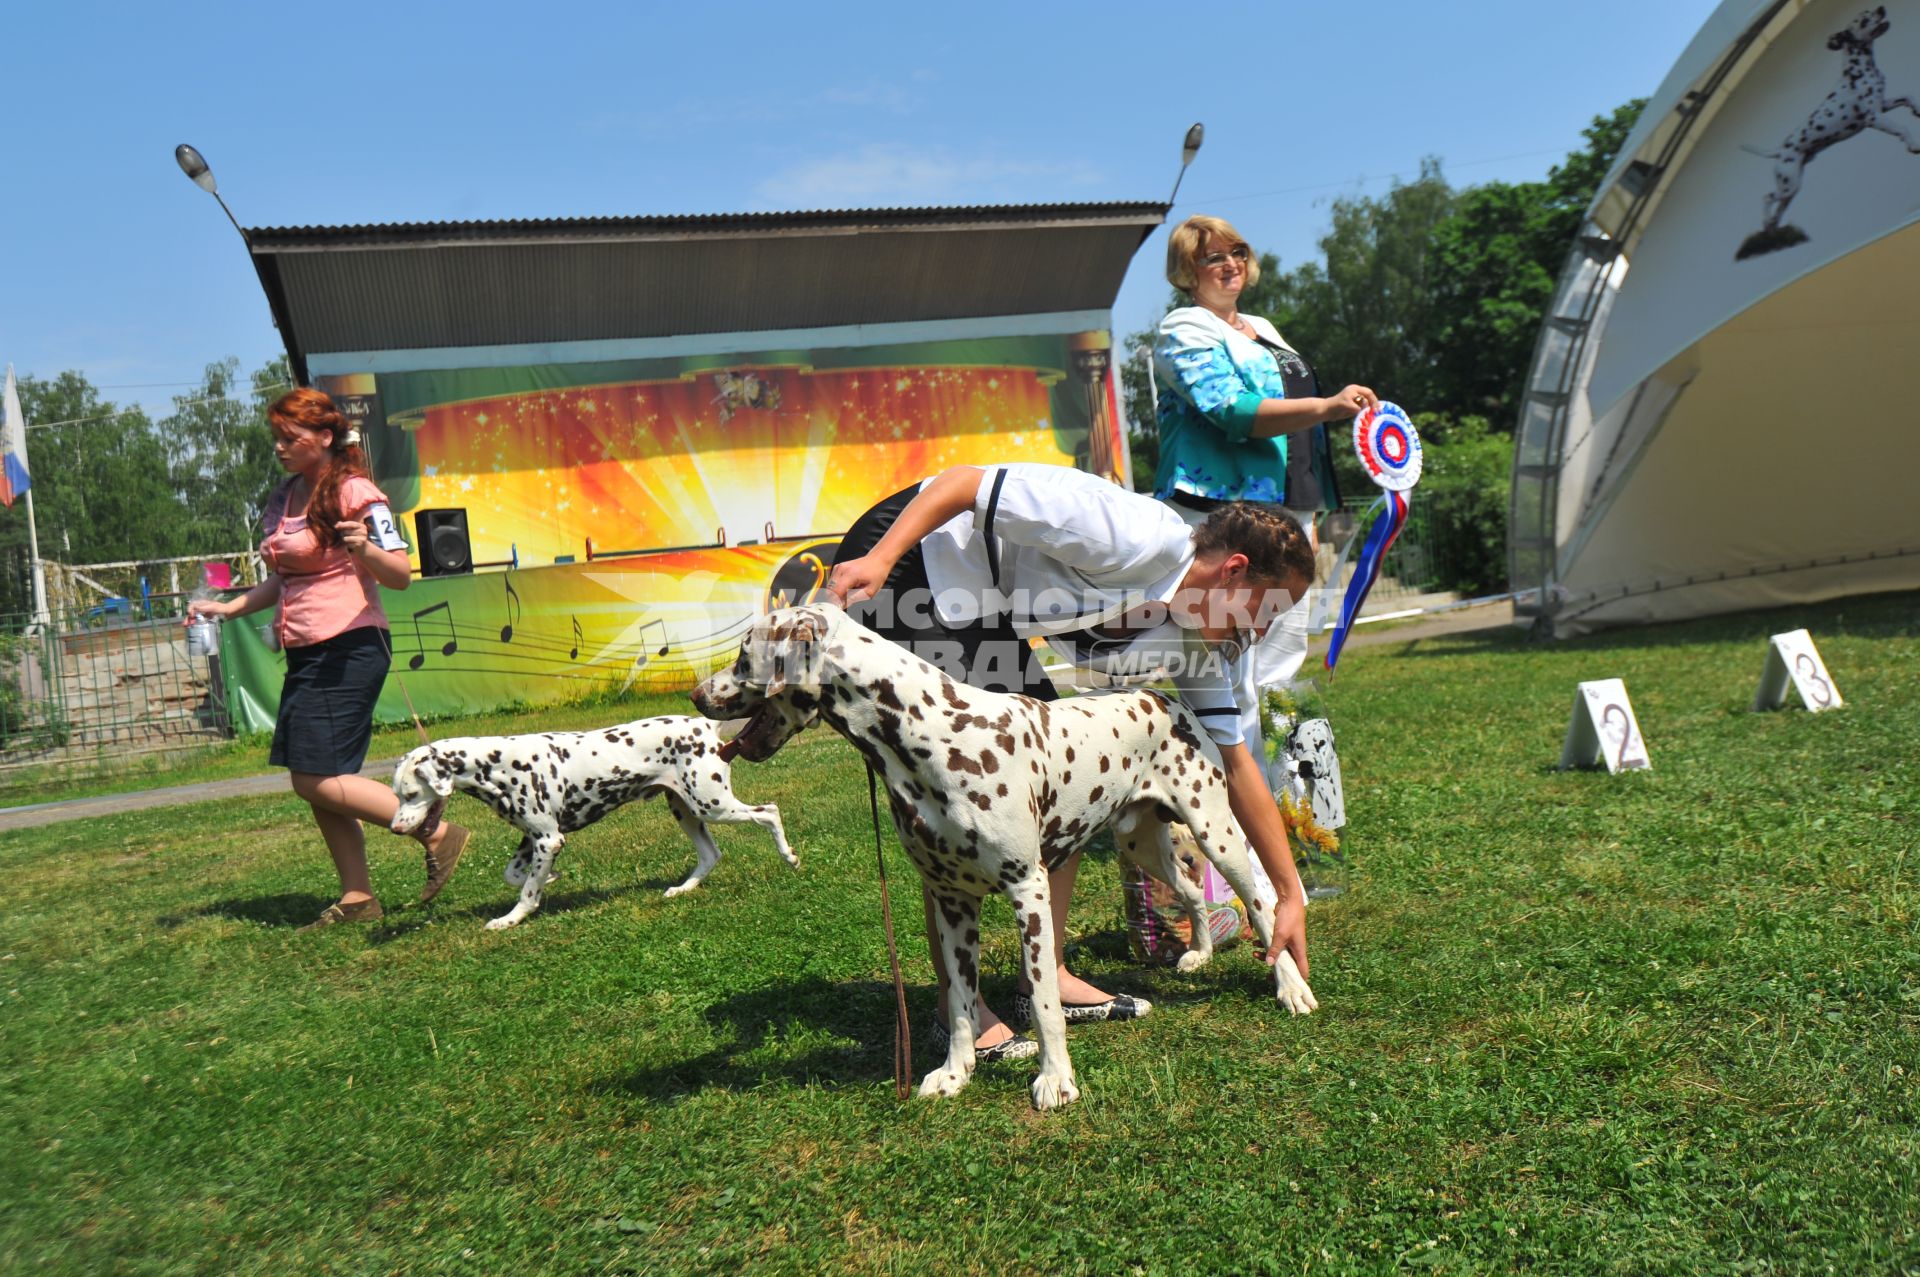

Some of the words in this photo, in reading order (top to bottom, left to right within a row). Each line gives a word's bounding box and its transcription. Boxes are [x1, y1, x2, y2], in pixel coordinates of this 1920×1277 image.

[381, 519, 393, 534] 2
[1796, 652, 1831, 707] 3
[1603, 703, 1645, 769] 2
